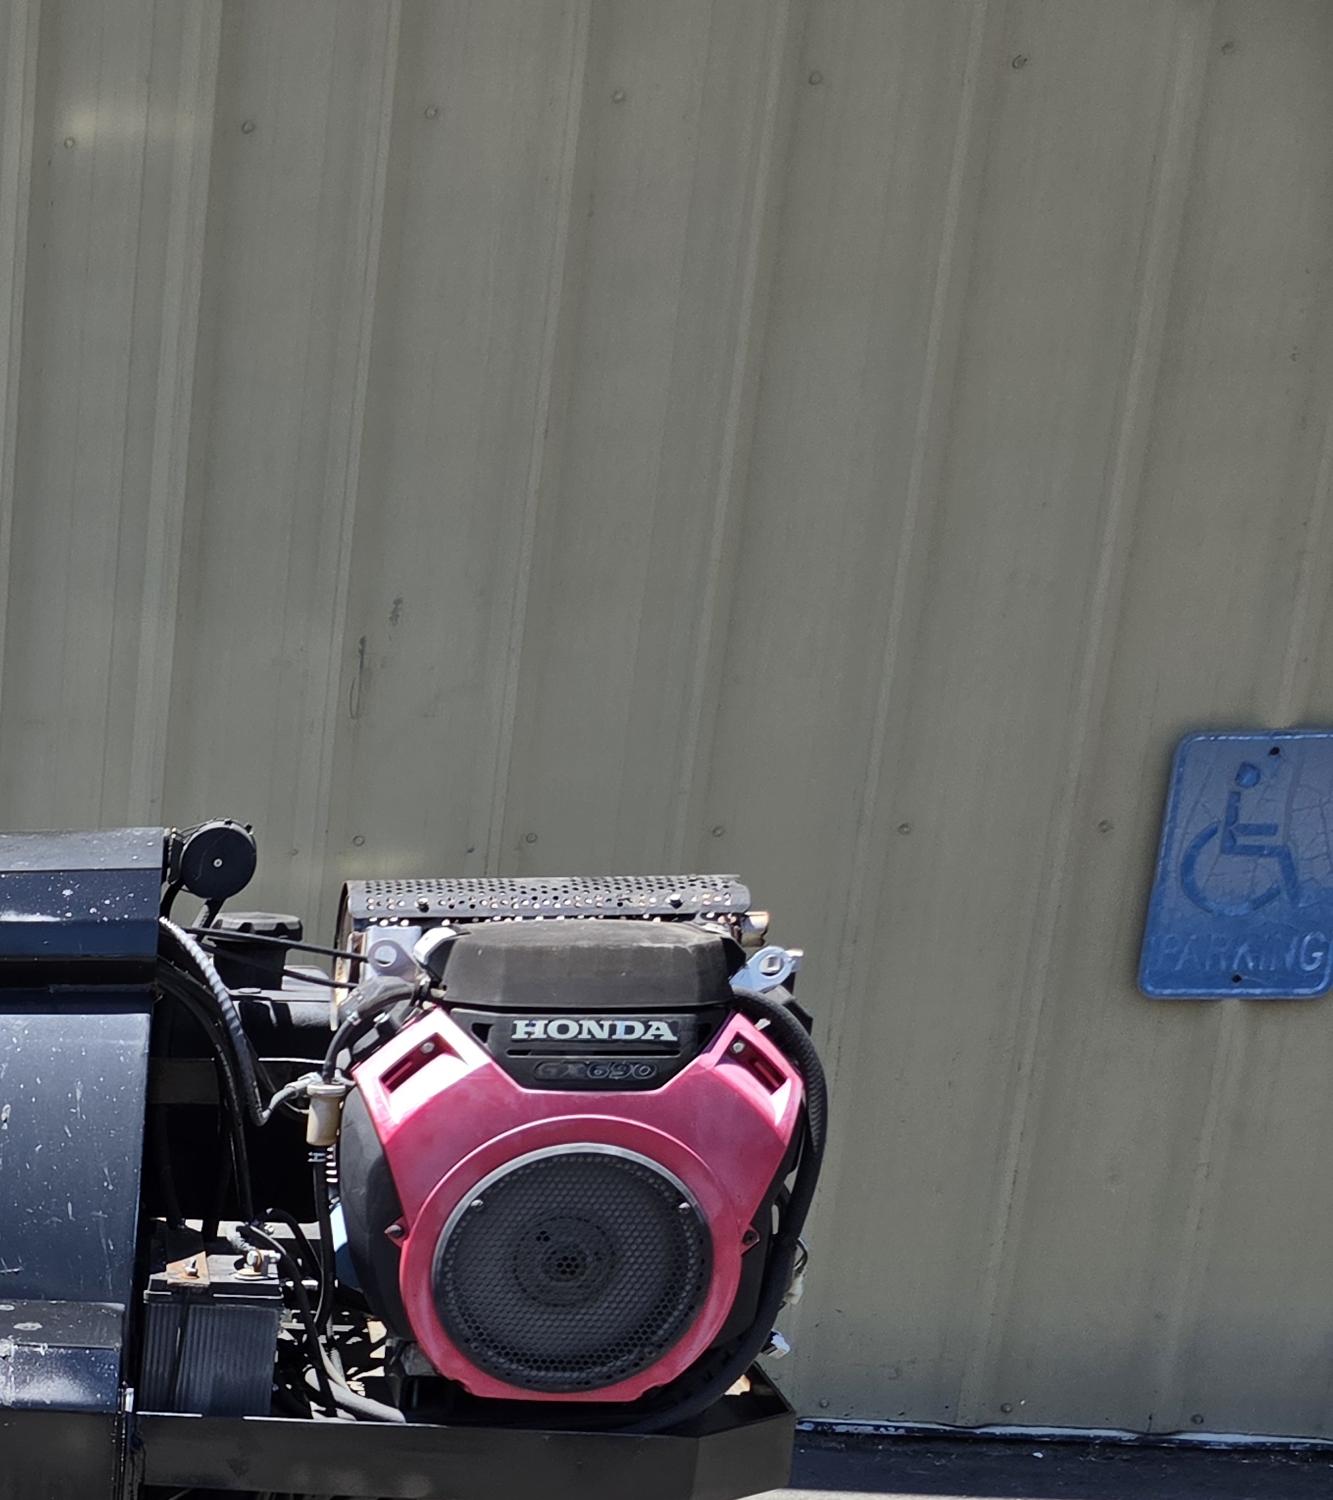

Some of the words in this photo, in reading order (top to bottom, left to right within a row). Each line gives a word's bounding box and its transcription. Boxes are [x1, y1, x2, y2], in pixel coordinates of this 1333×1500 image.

[1159, 931, 1327, 972] PARKING
[511, 1019, 678, 1041] HONDA
[535, 1060, 658, 1080] GX690
